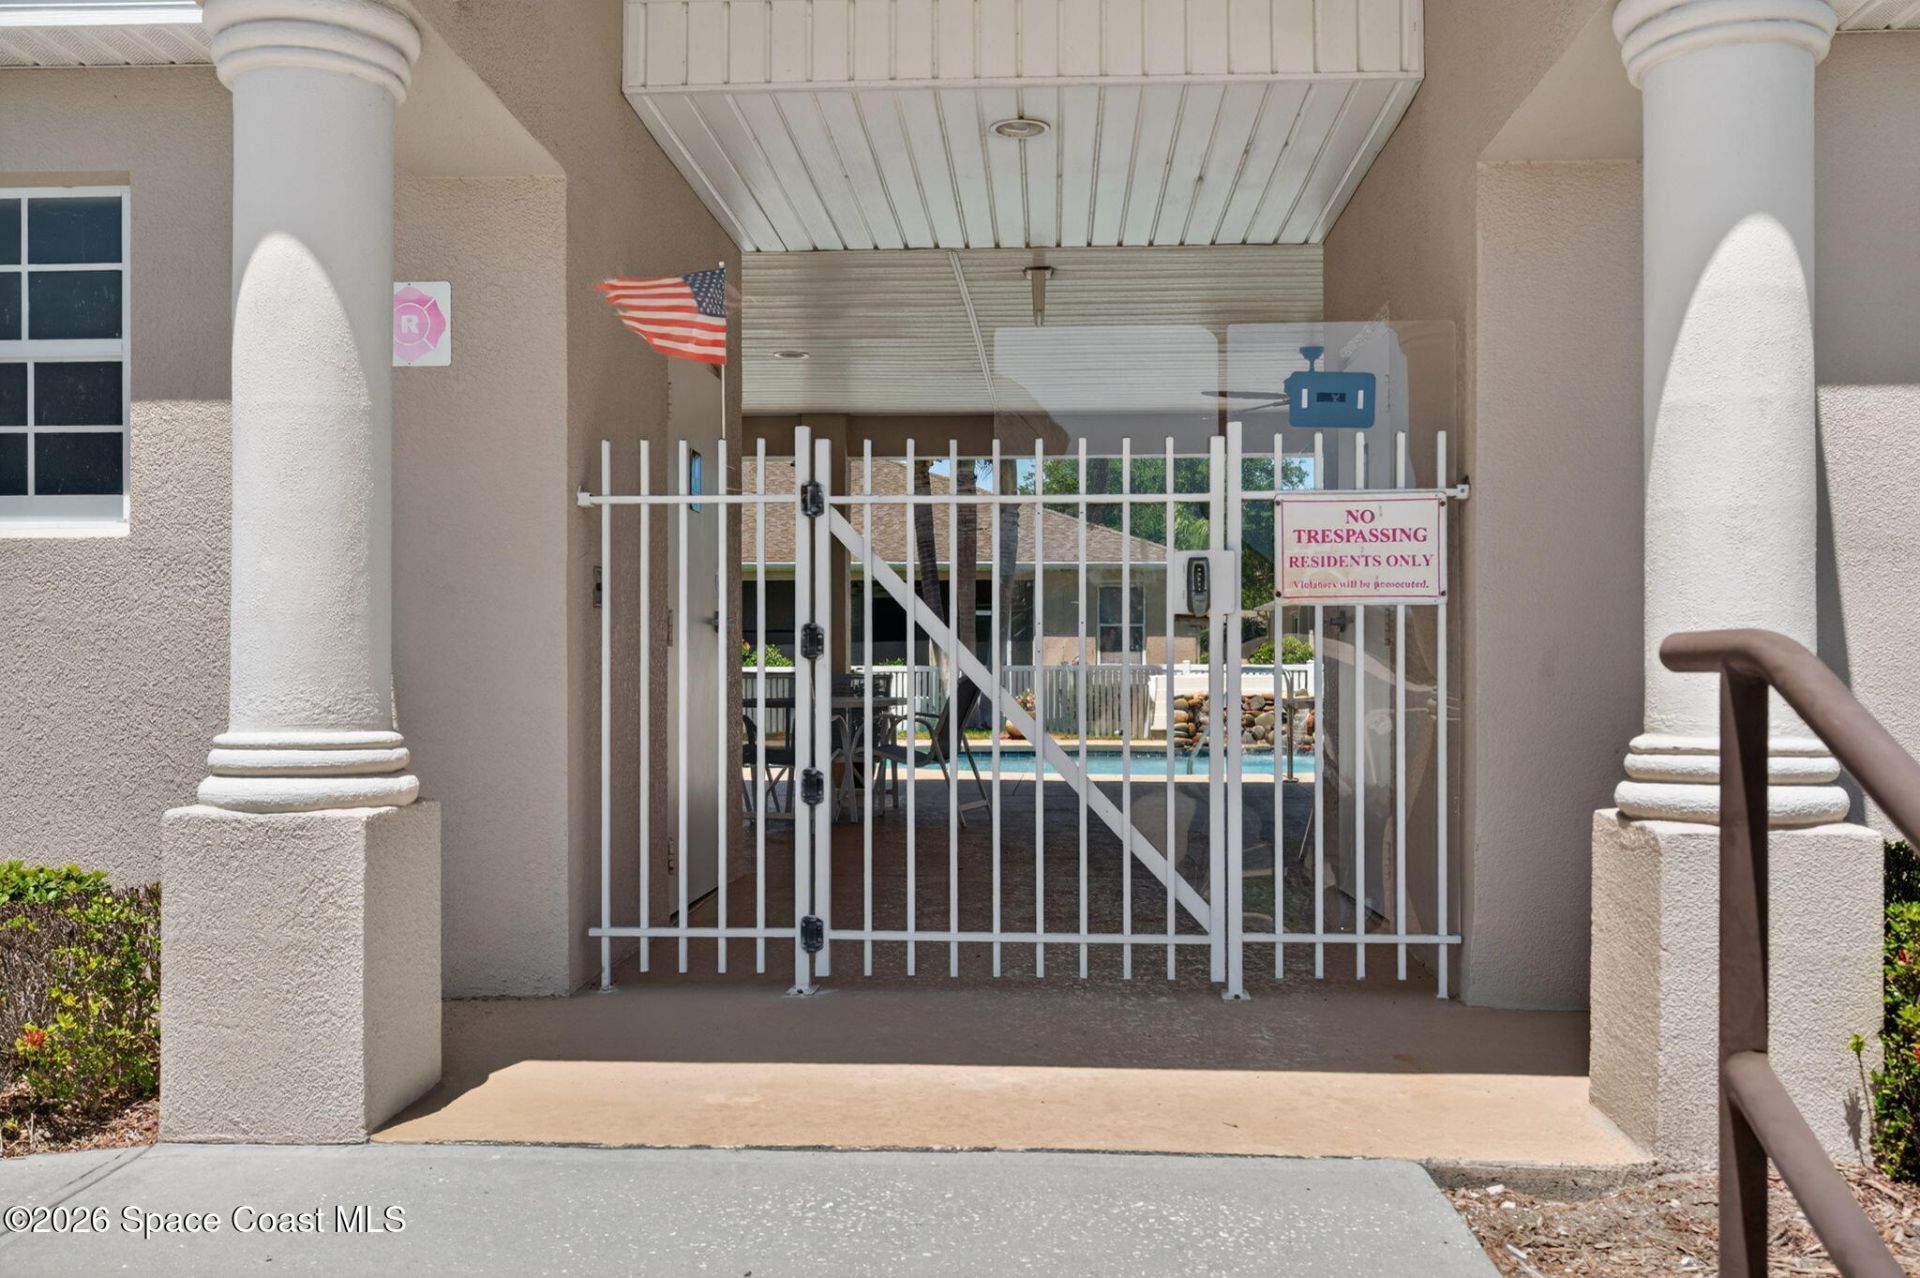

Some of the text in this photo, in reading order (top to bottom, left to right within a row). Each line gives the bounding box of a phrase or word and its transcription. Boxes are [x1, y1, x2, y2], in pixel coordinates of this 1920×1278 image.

[401, 314, 419, 335] R
[1345, 509, 1376, 525] NO
[1292, 527, 1428, 544] TRESPASSING
[1289, 553, 1434, 569] RESIDENTS ONLY
[1340, 580, 1358, 589] will
[1360, 580, 1371, 589] be
